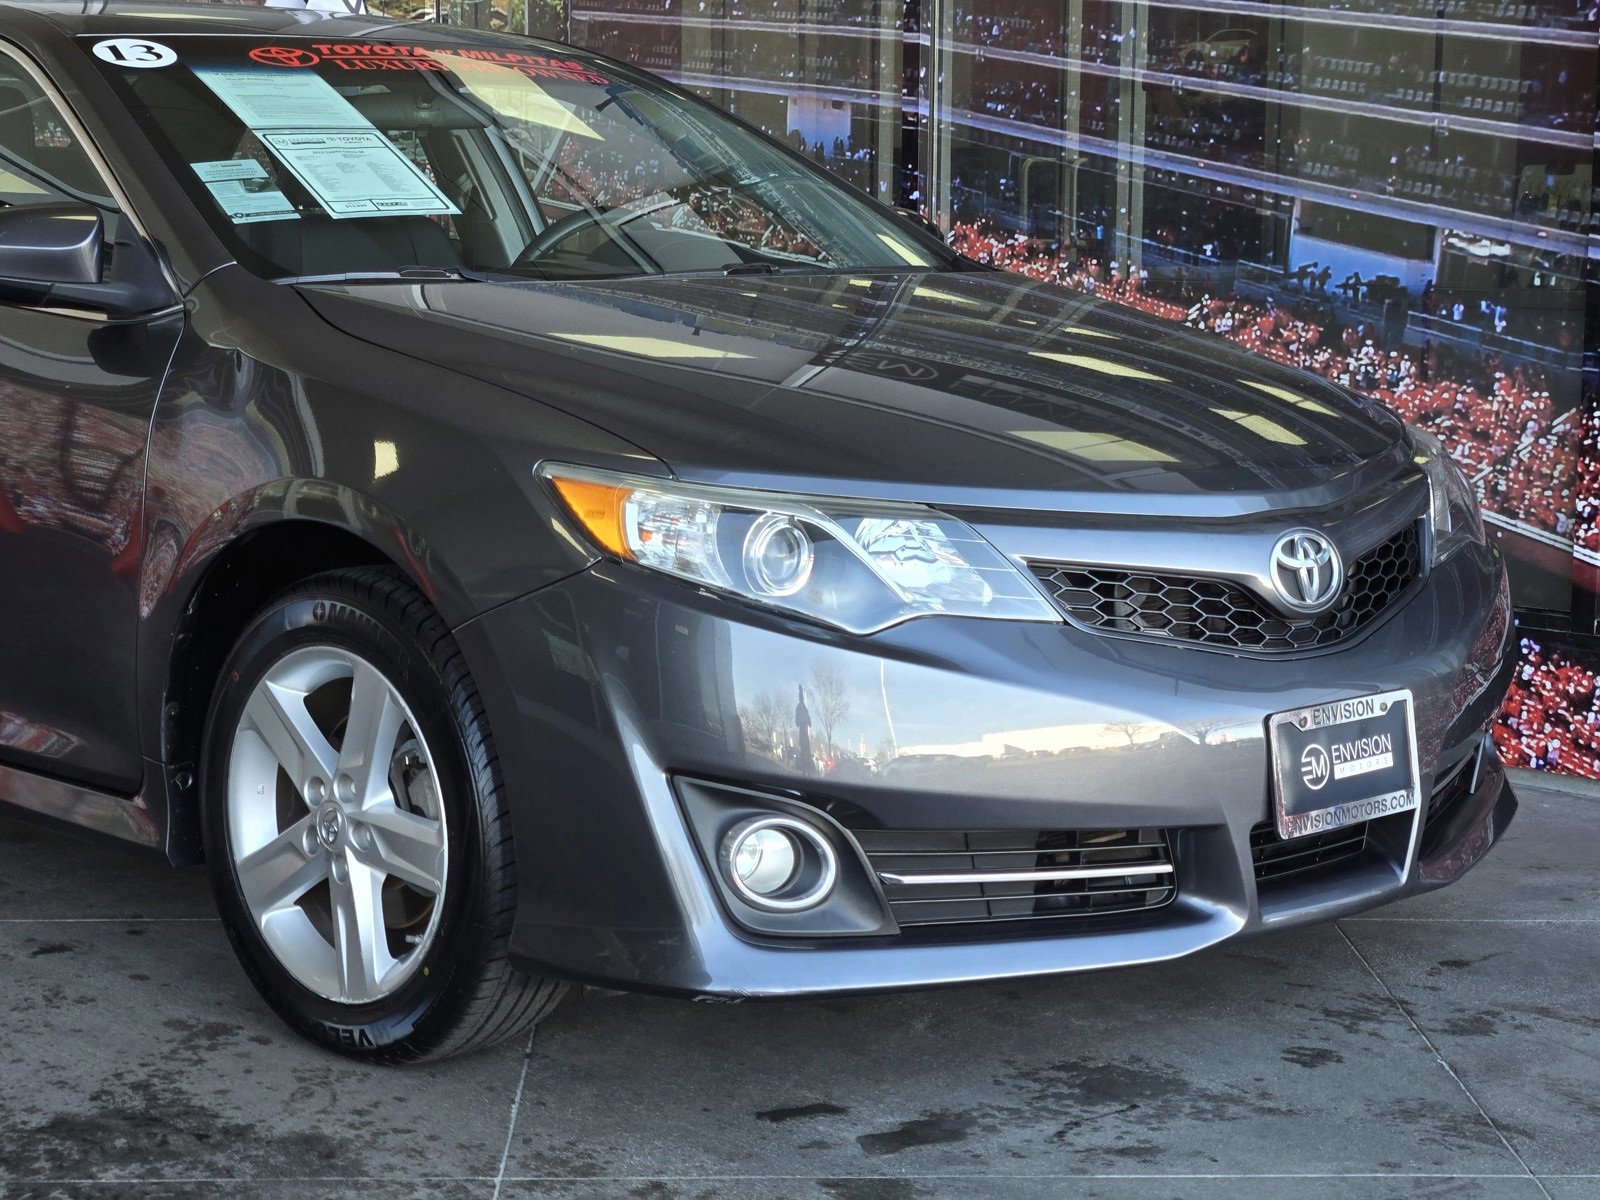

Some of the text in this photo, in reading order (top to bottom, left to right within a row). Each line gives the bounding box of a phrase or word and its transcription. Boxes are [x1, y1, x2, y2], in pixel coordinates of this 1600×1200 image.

[101, 44, 163, 61] 13
[311, 44, 427, 56] TOYOTA
[457, 49, 584, 71] MILPITAS
[331, 59, 450, 71] LUXURY
[512, 65, 609, 85] OWNED
[1313, 699, 1375, 725] ENVISION
[1331, 734, 1392, 764] ENVISION
[1287, 793, 1415, 834] ENVISIONMOTORS.COM
